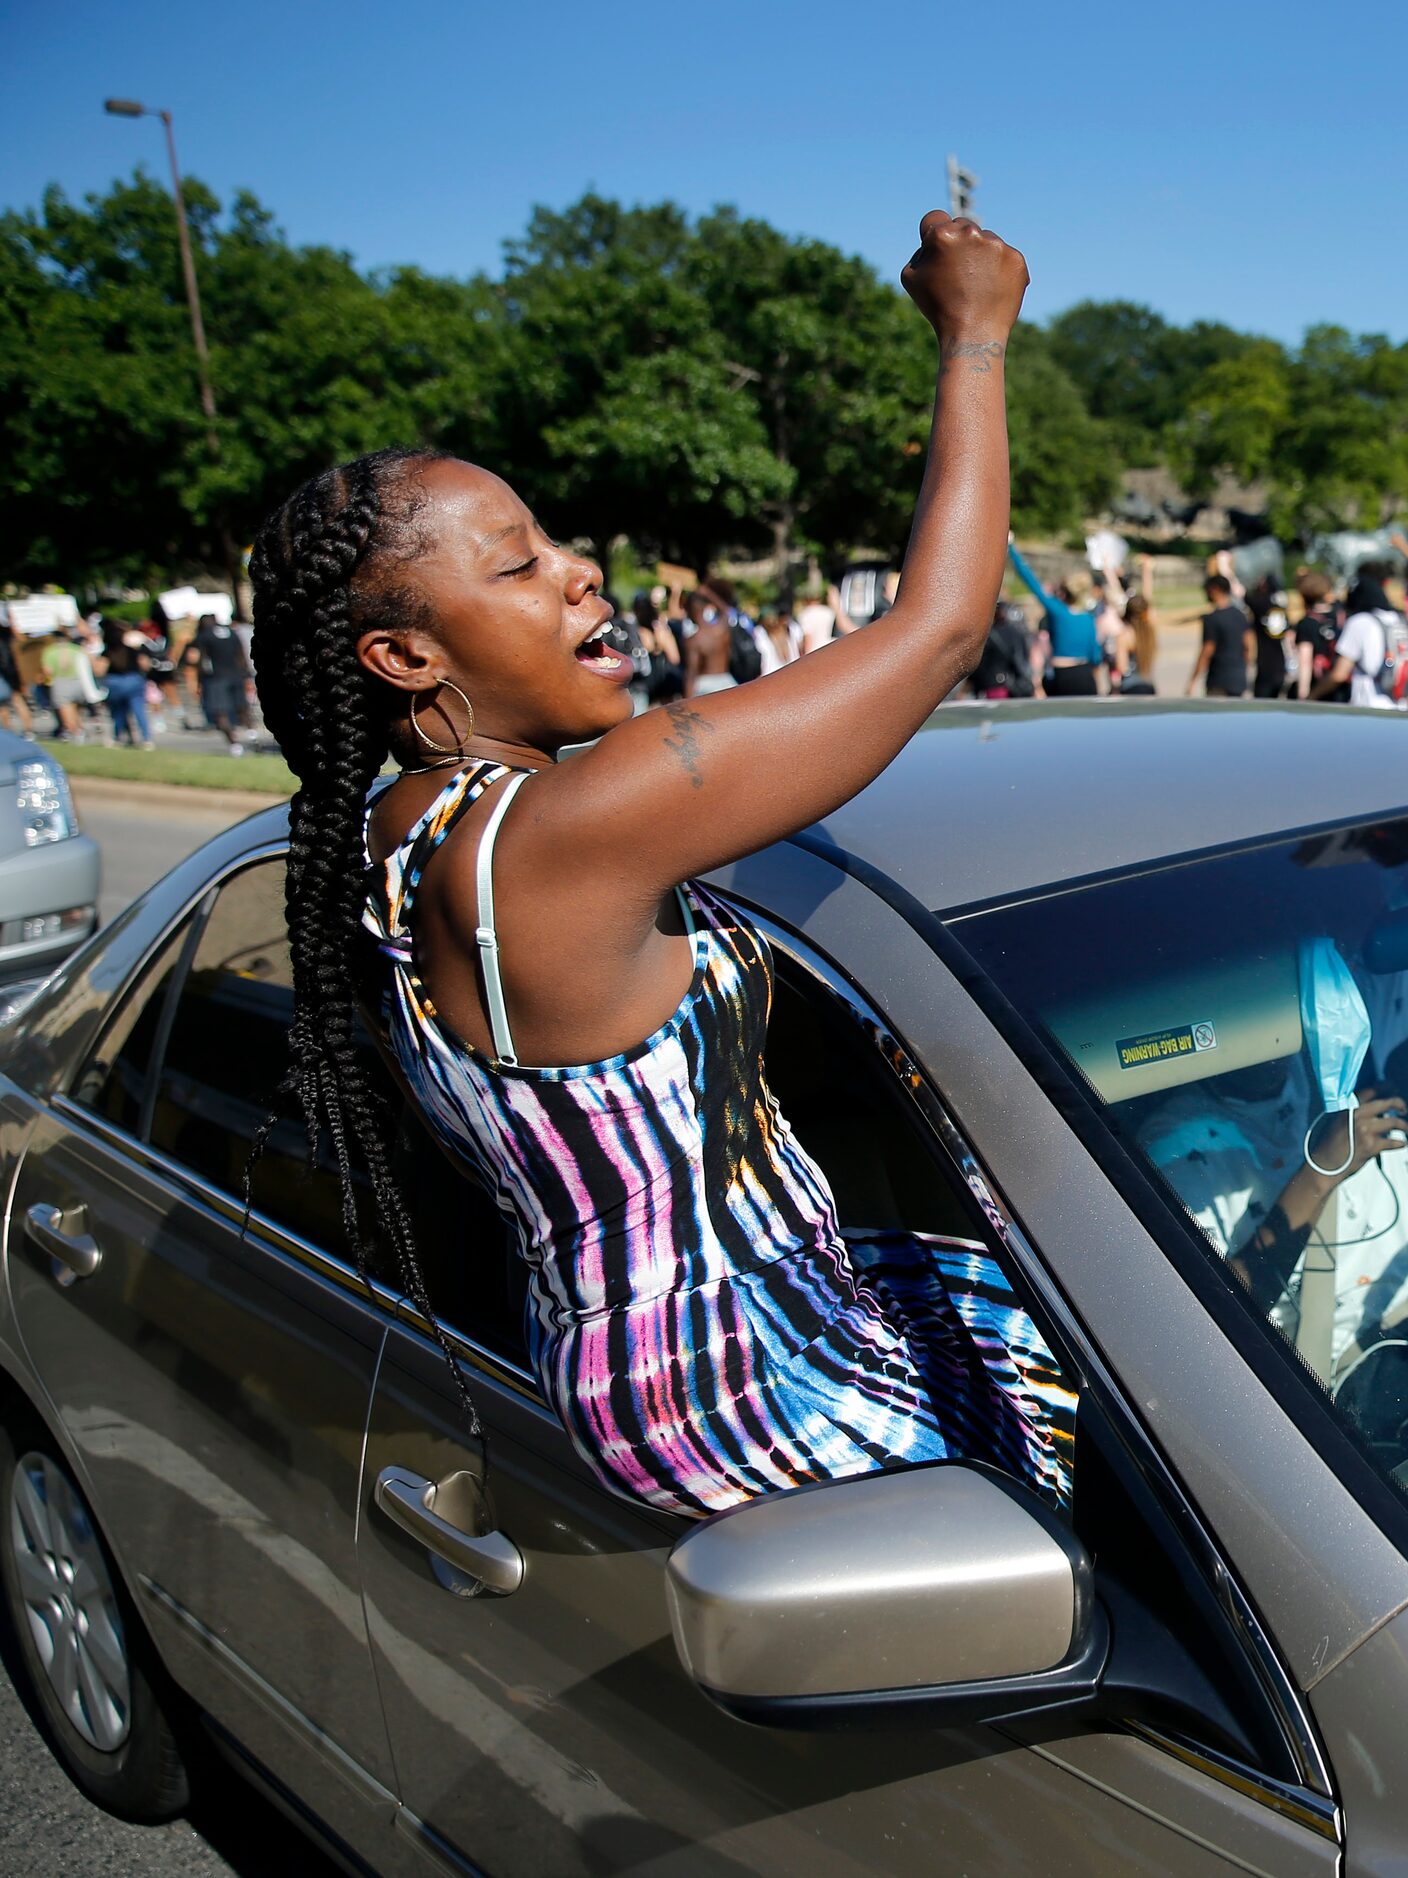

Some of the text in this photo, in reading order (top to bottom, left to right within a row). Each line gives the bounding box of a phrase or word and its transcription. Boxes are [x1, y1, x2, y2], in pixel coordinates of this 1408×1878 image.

[1121, 1034, 1192, 1064] AIR BAG WARNING
